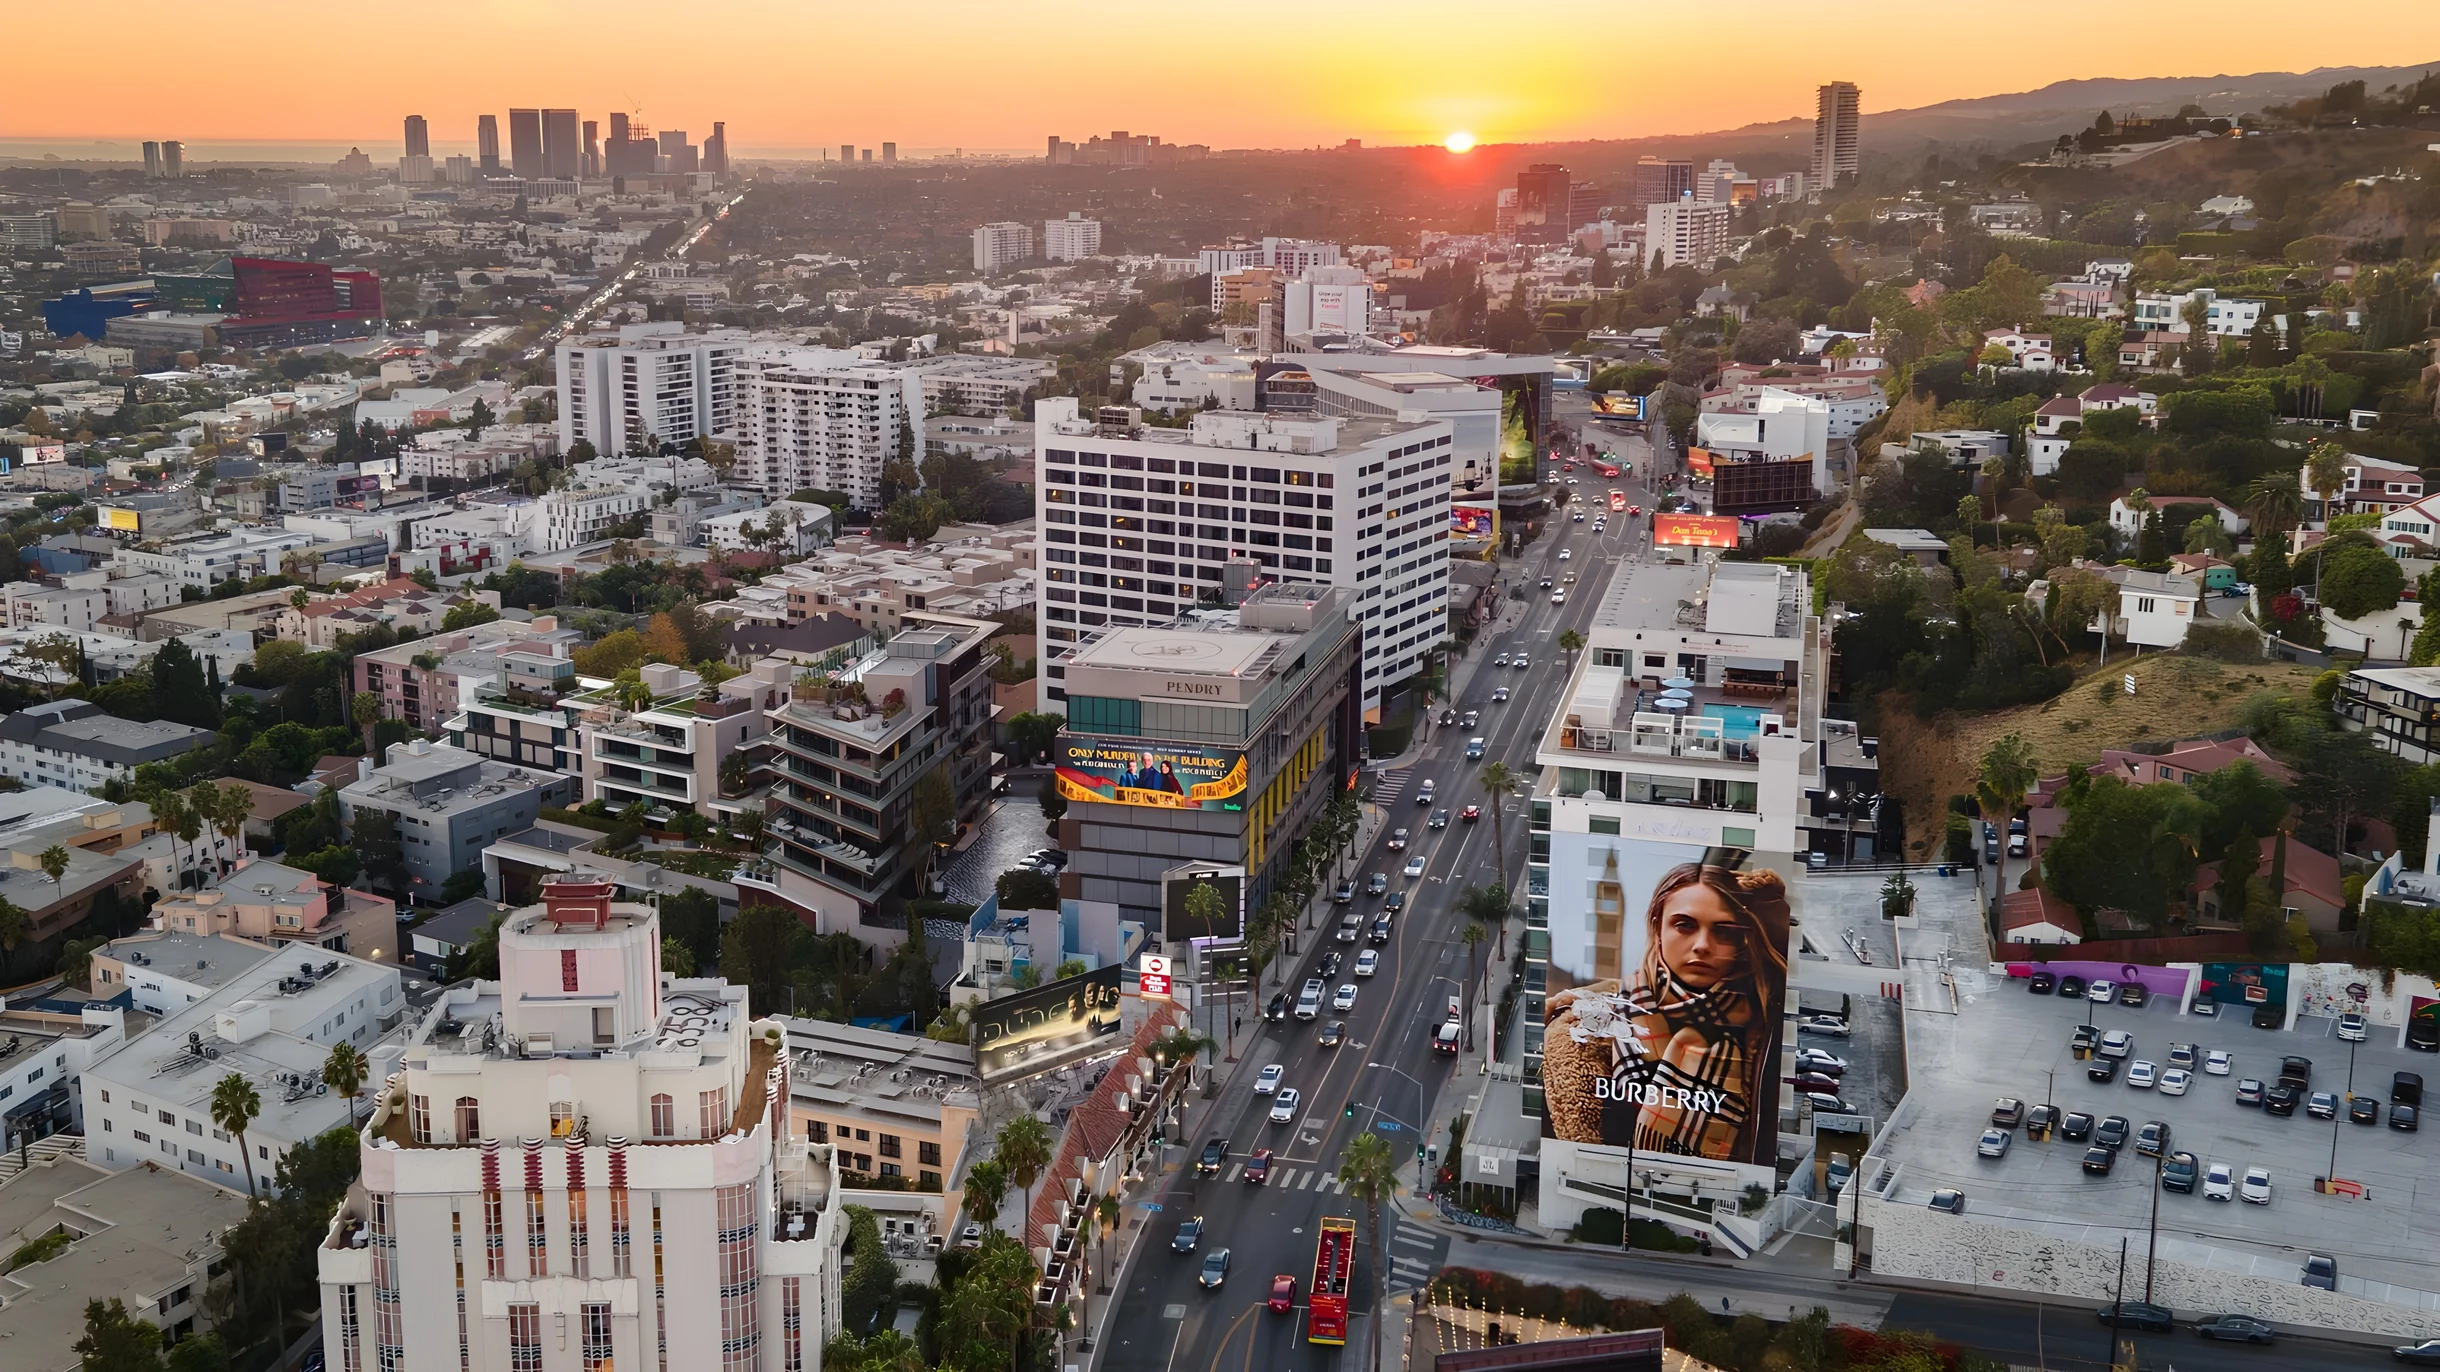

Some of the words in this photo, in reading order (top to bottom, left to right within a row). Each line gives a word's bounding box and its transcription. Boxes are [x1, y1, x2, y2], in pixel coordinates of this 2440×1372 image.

[1167, 681, 1222, 696] PENDRY
[1068, 747, 1094, 758] ONLY
[1181, 755, 1225, 768] BUILDING
[1595, 1077, 1727, 1114] BURBERRY
